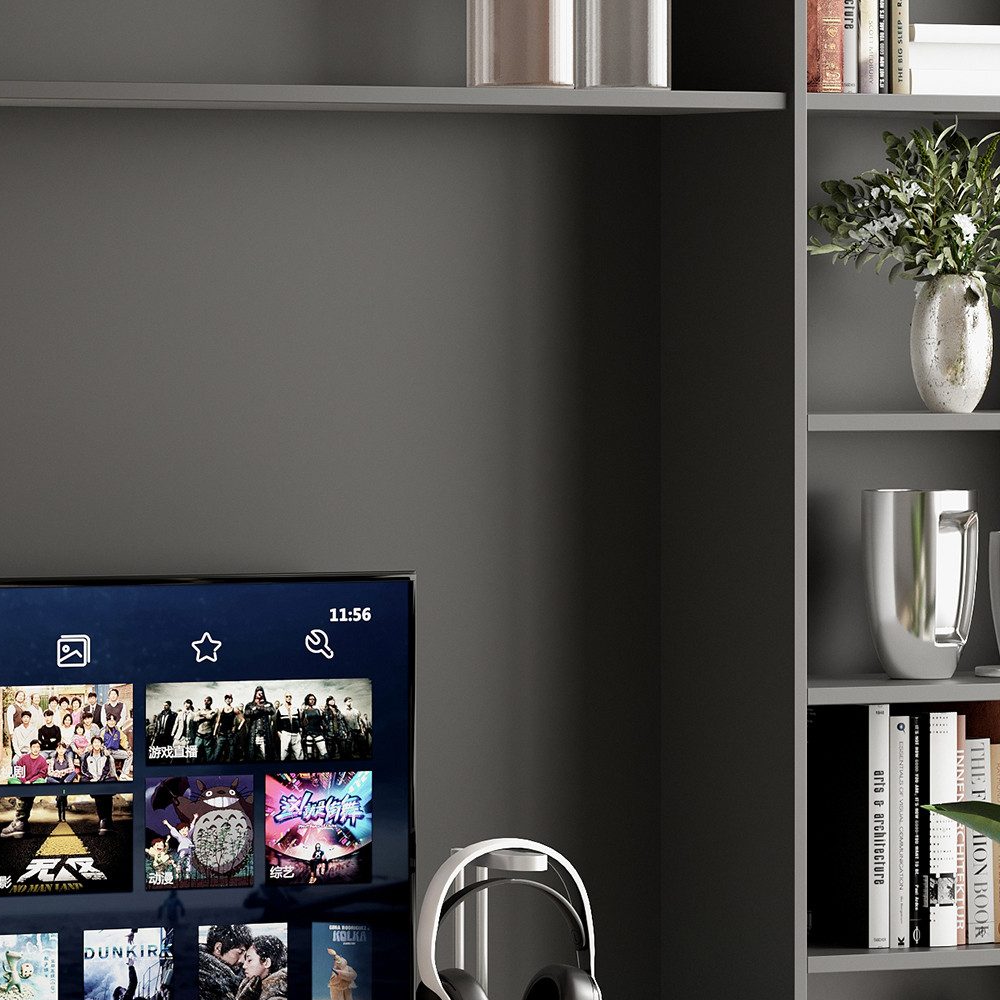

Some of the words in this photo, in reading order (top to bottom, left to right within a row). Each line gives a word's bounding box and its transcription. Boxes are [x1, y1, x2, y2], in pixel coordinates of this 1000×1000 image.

[329, 607, 372, 622] 11:56
[148, 745, 198, 759] 游戏直播
[971, 742, 985, 784] THE
[873, 770, 885, 793] arts
[873, 813, 886, 885] architecture
[148, 871, 174, 885] 动漫
[269, 865, 295, 879] 综艺
[28, 883, 53, 893] MAN
[973, 882, 989, 938] BOOK
[84, 944, 173, 960] DUNKIRK
